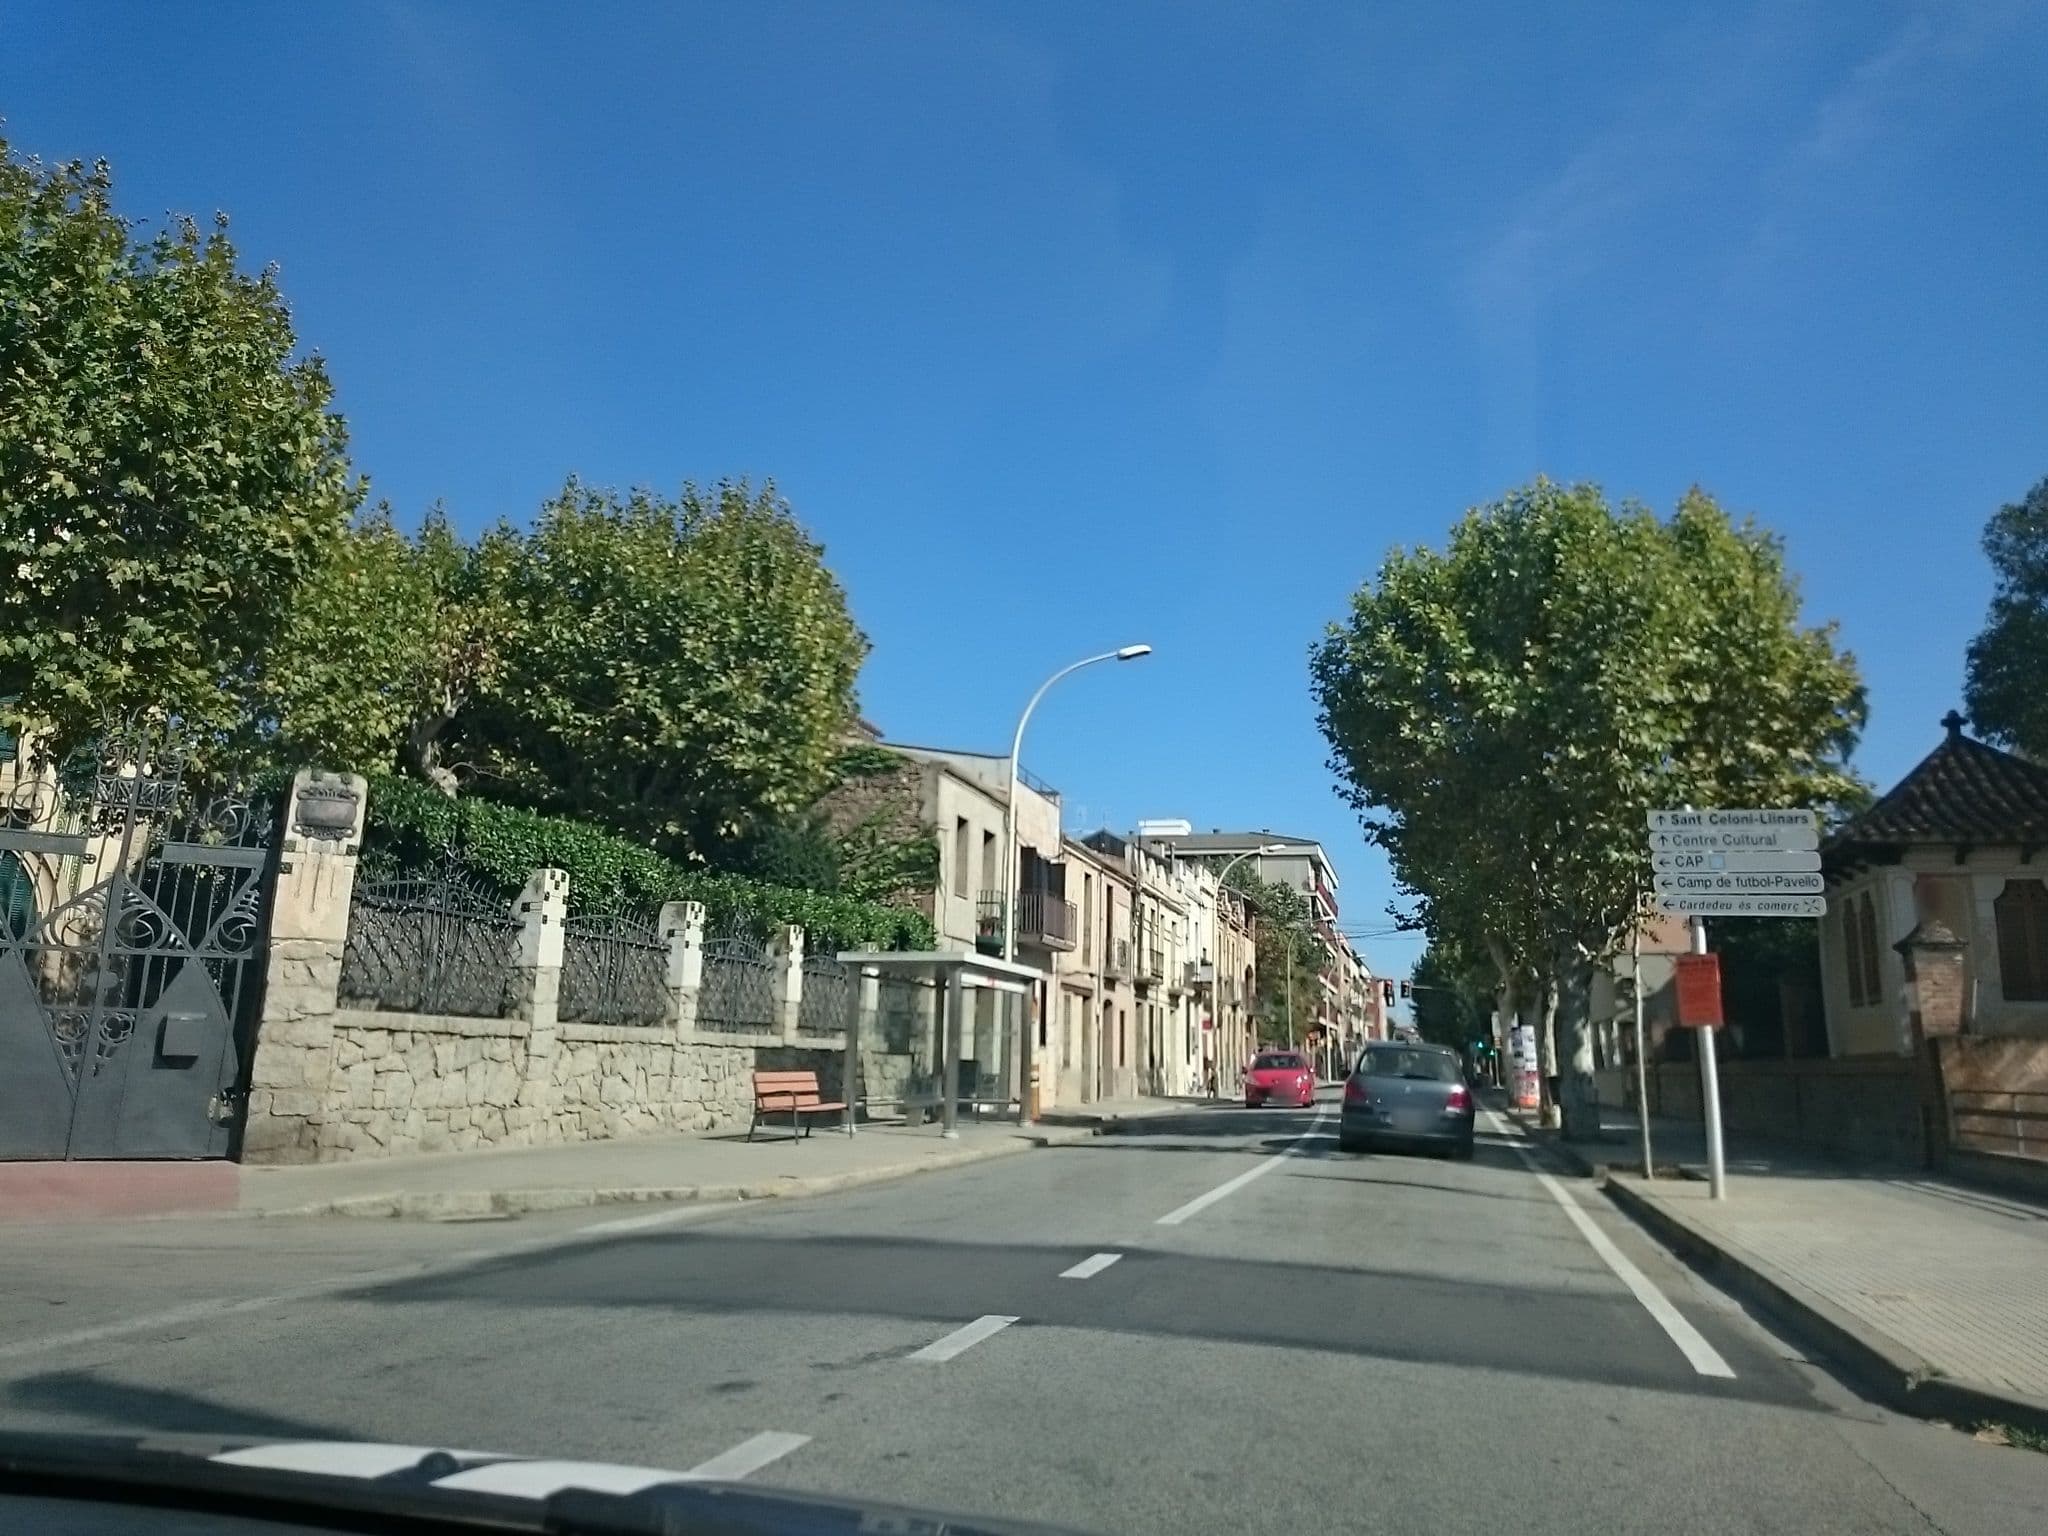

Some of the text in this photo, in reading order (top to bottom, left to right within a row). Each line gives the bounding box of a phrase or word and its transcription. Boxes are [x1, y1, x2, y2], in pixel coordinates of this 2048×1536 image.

[1671, 814, 1702, 825] Sant
[1672, 833, 1777, 846] Centre Cultural
[1675, 855, 1704, 868] CAP
[1677, 876, 1712, 890] Camp
[1716, 876, 1731, 888] de
[1679, 900, 1732, 910] Cardedeu
